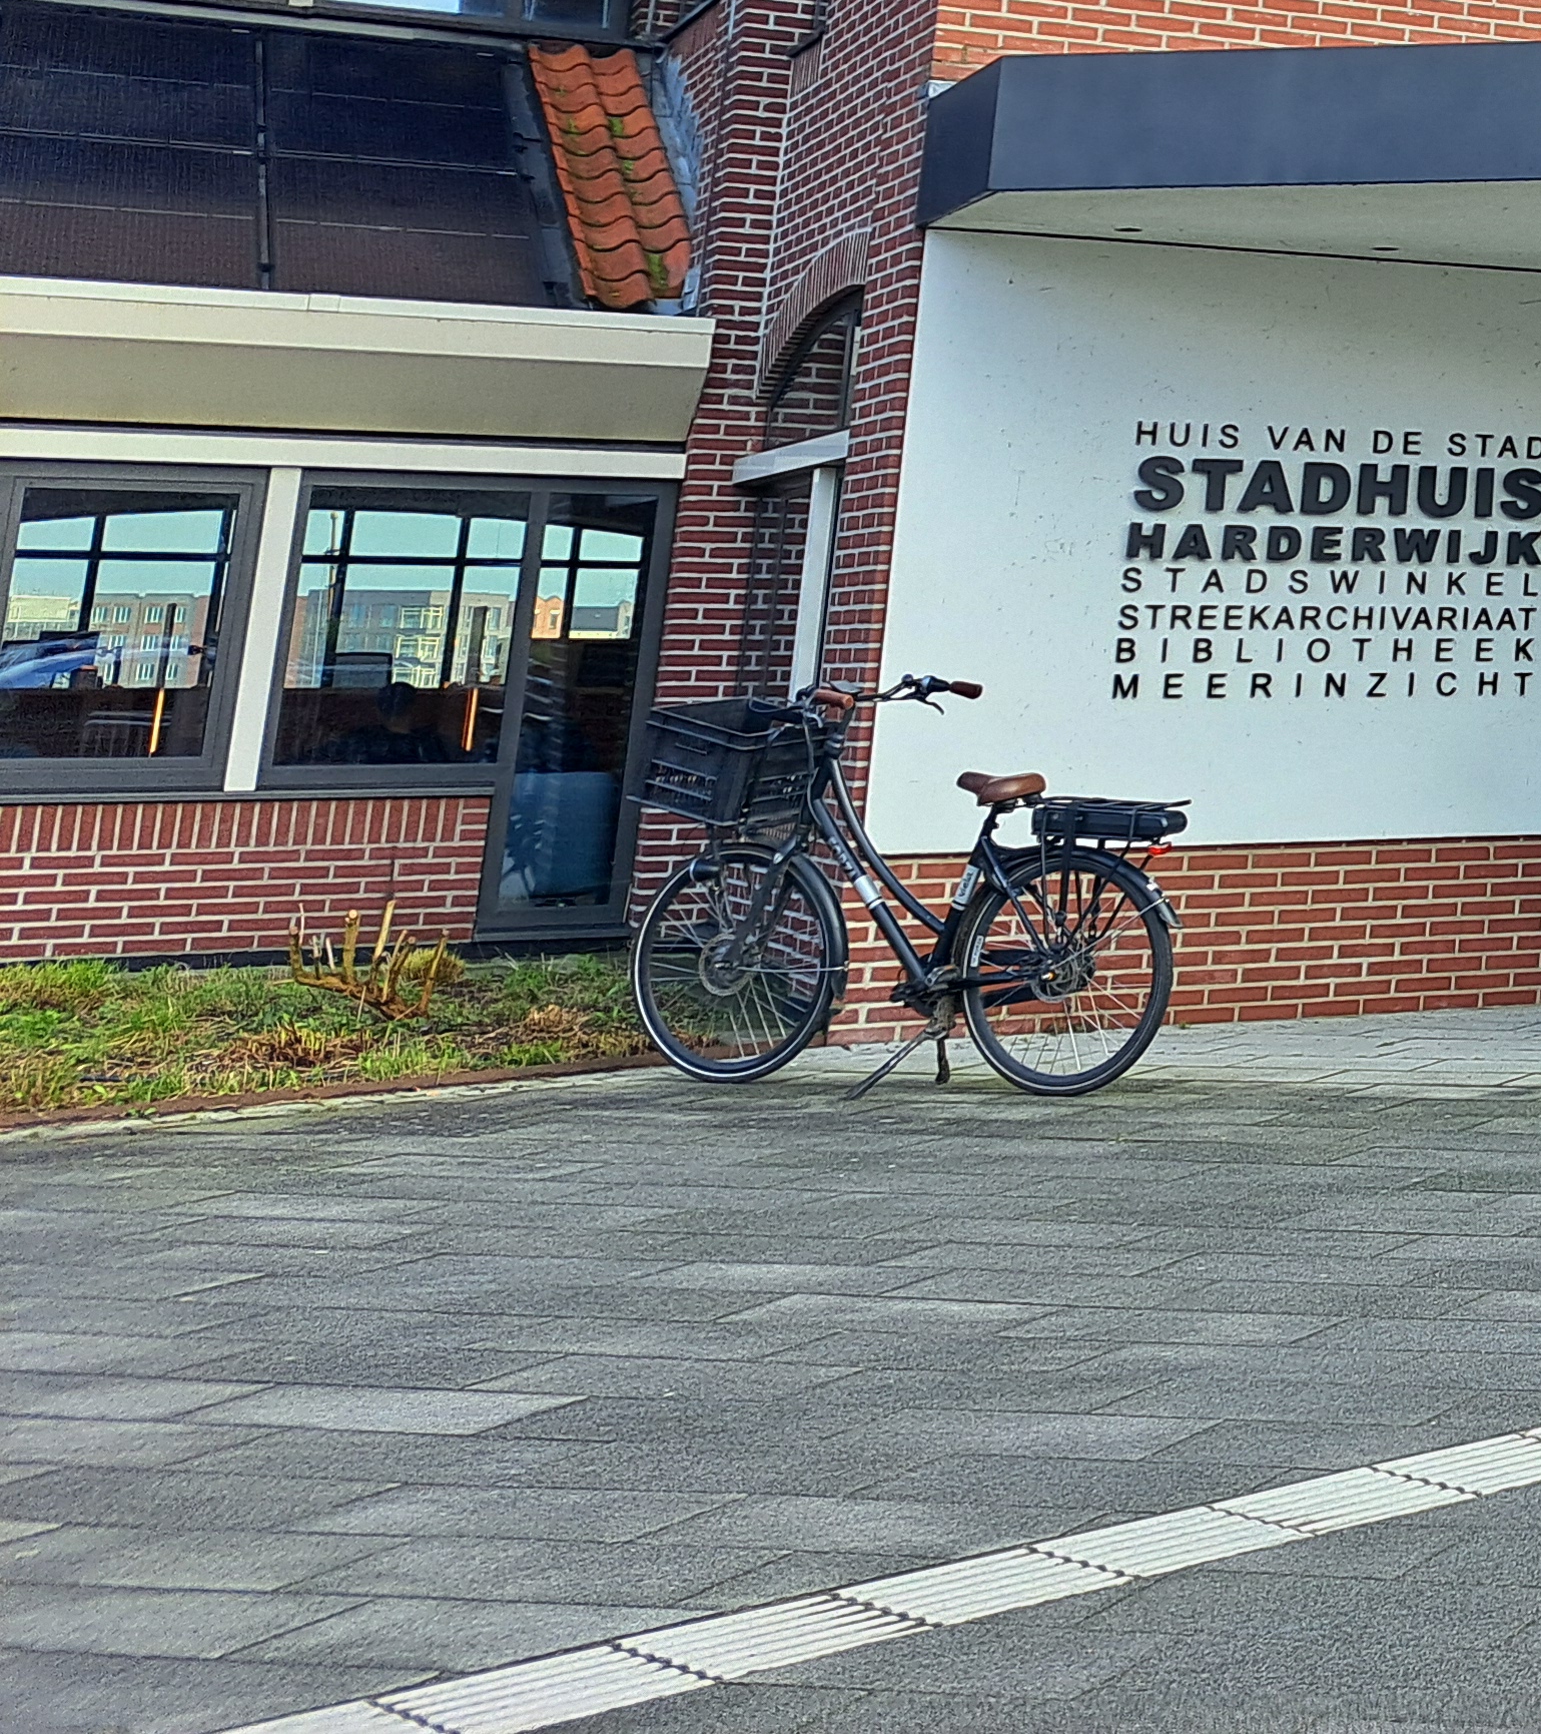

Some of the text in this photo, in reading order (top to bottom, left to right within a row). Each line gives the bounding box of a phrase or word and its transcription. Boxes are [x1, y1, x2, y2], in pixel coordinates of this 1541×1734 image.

[1135, 420, 1239, 449] HUIS
[1267, 425, 1346, 453] VAN
[1372, 429, 1423, 456] DE
[1121, 567, 1539, 597] STADSWINKEL
[1118, 604, 1538, 631] STREEKARCHIVARIAAT
[1115, 637, 1534, 664] BIBLIOTHEEK
[1112, 671, 1533, 699] MEERINZICHT
